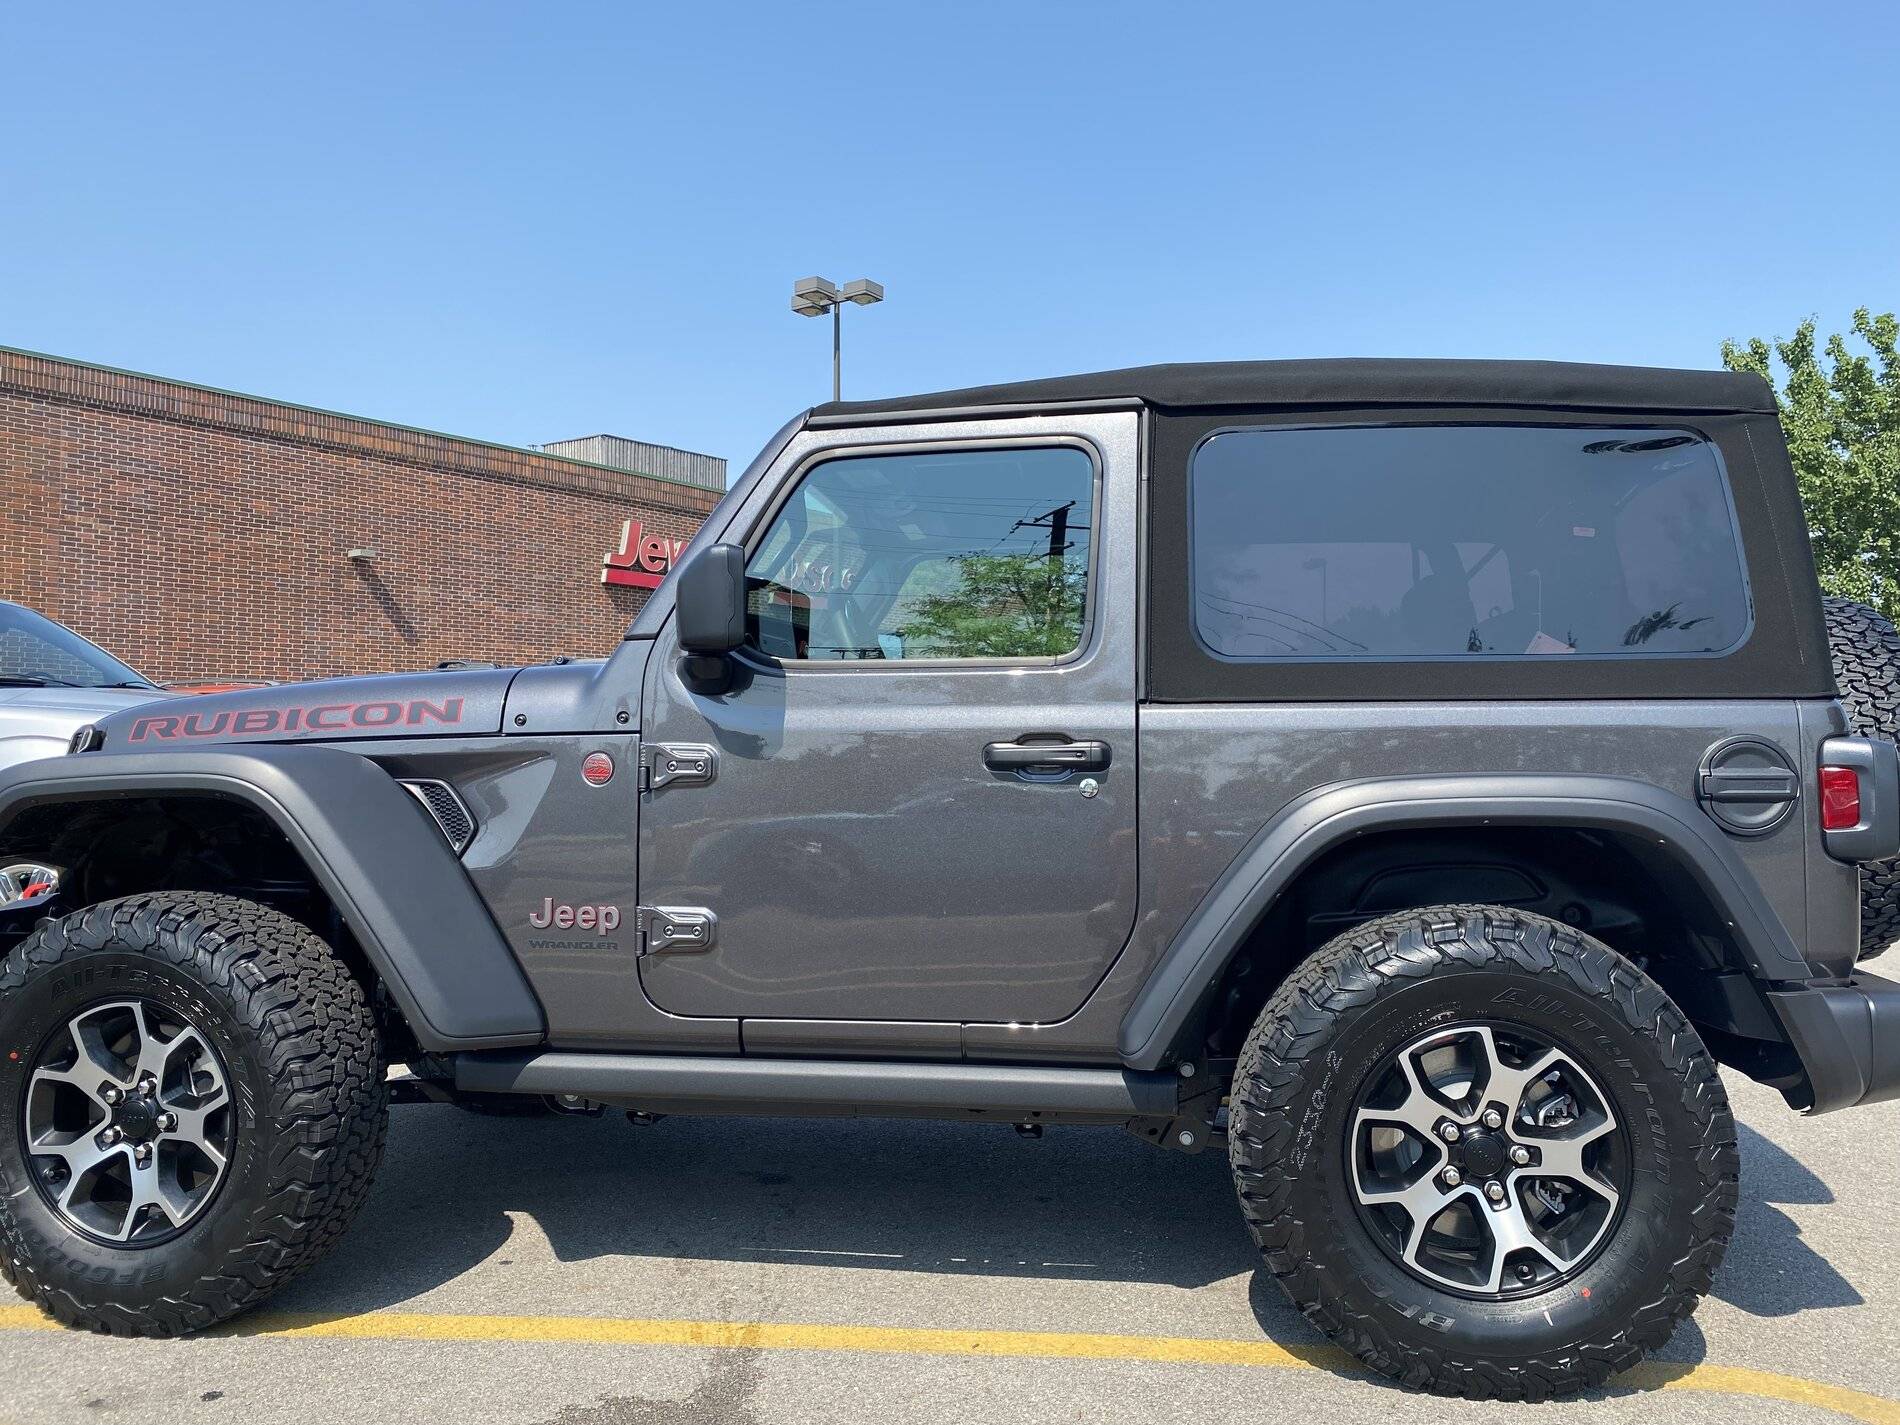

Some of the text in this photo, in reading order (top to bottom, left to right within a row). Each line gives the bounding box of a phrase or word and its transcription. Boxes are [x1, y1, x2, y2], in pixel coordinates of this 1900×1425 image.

[129, 697, 464, 743] RUBICON
[530, 897, 620, 936] Jeep
[529, 939, 618, 950] WRANGLER
